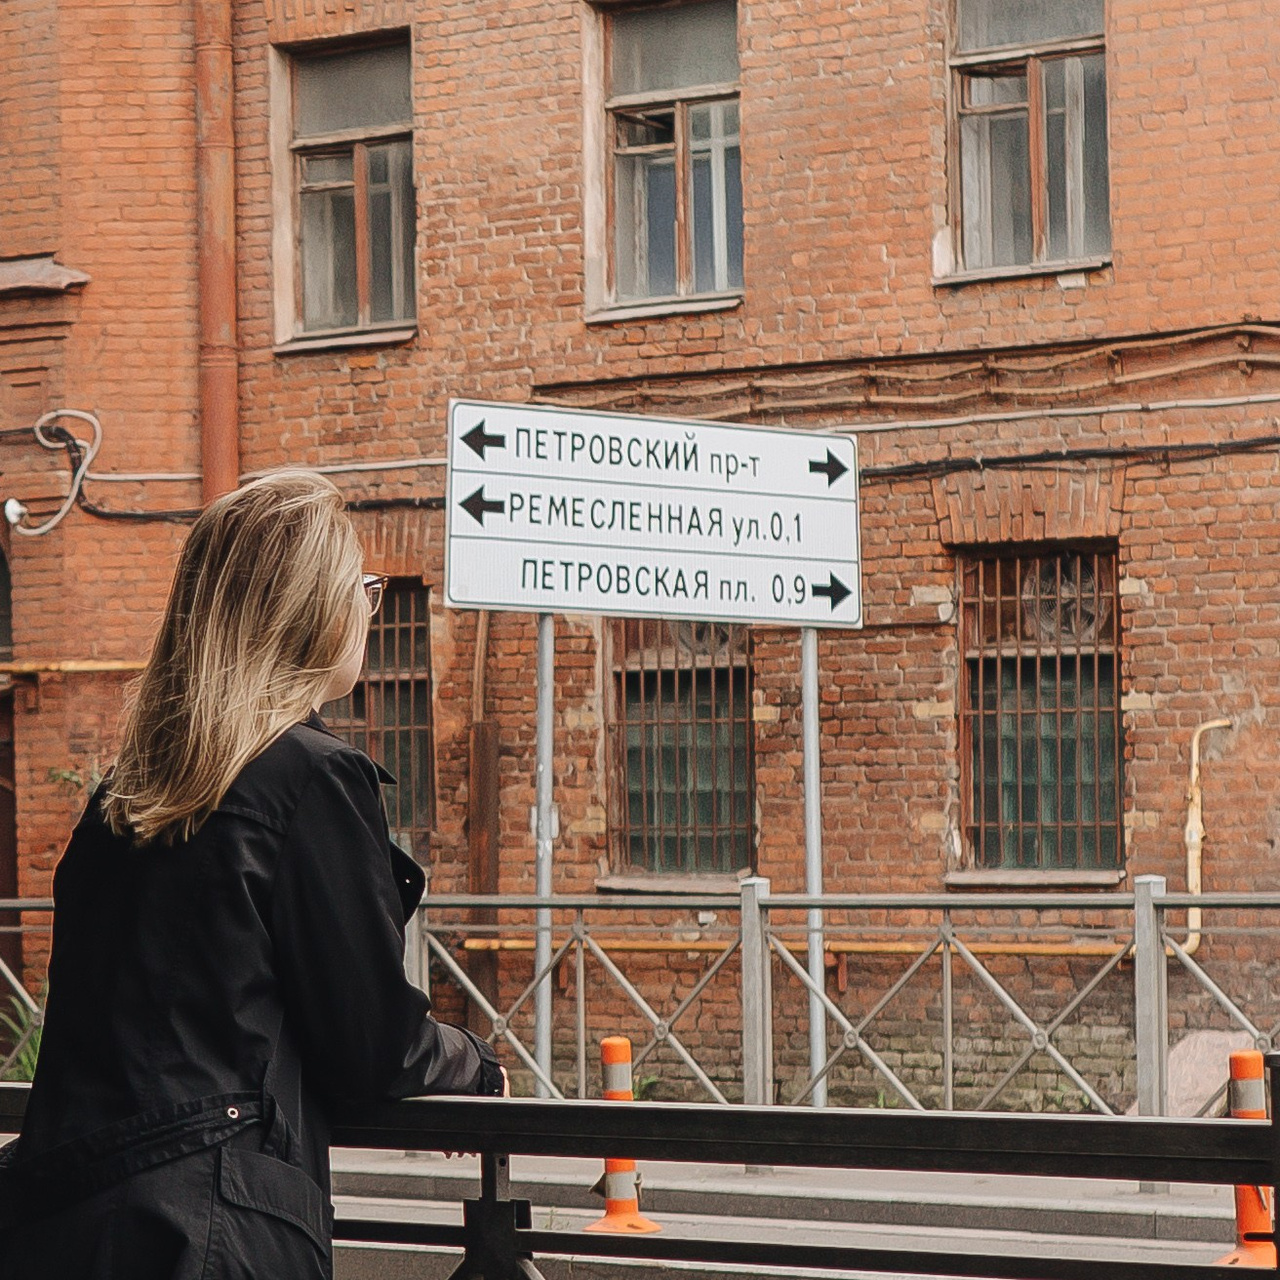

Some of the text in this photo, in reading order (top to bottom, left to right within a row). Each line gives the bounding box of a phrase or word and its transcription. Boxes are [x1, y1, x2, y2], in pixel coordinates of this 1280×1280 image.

[515, 427, 761, 483] ПЕТРОВСКИЙ пр-т
[509, 493, 723, 538] РЕМЕСЛЕННАЯ
[521, 559, 806, 605] ПЕТРОВСКАЯ пл. 0,9
